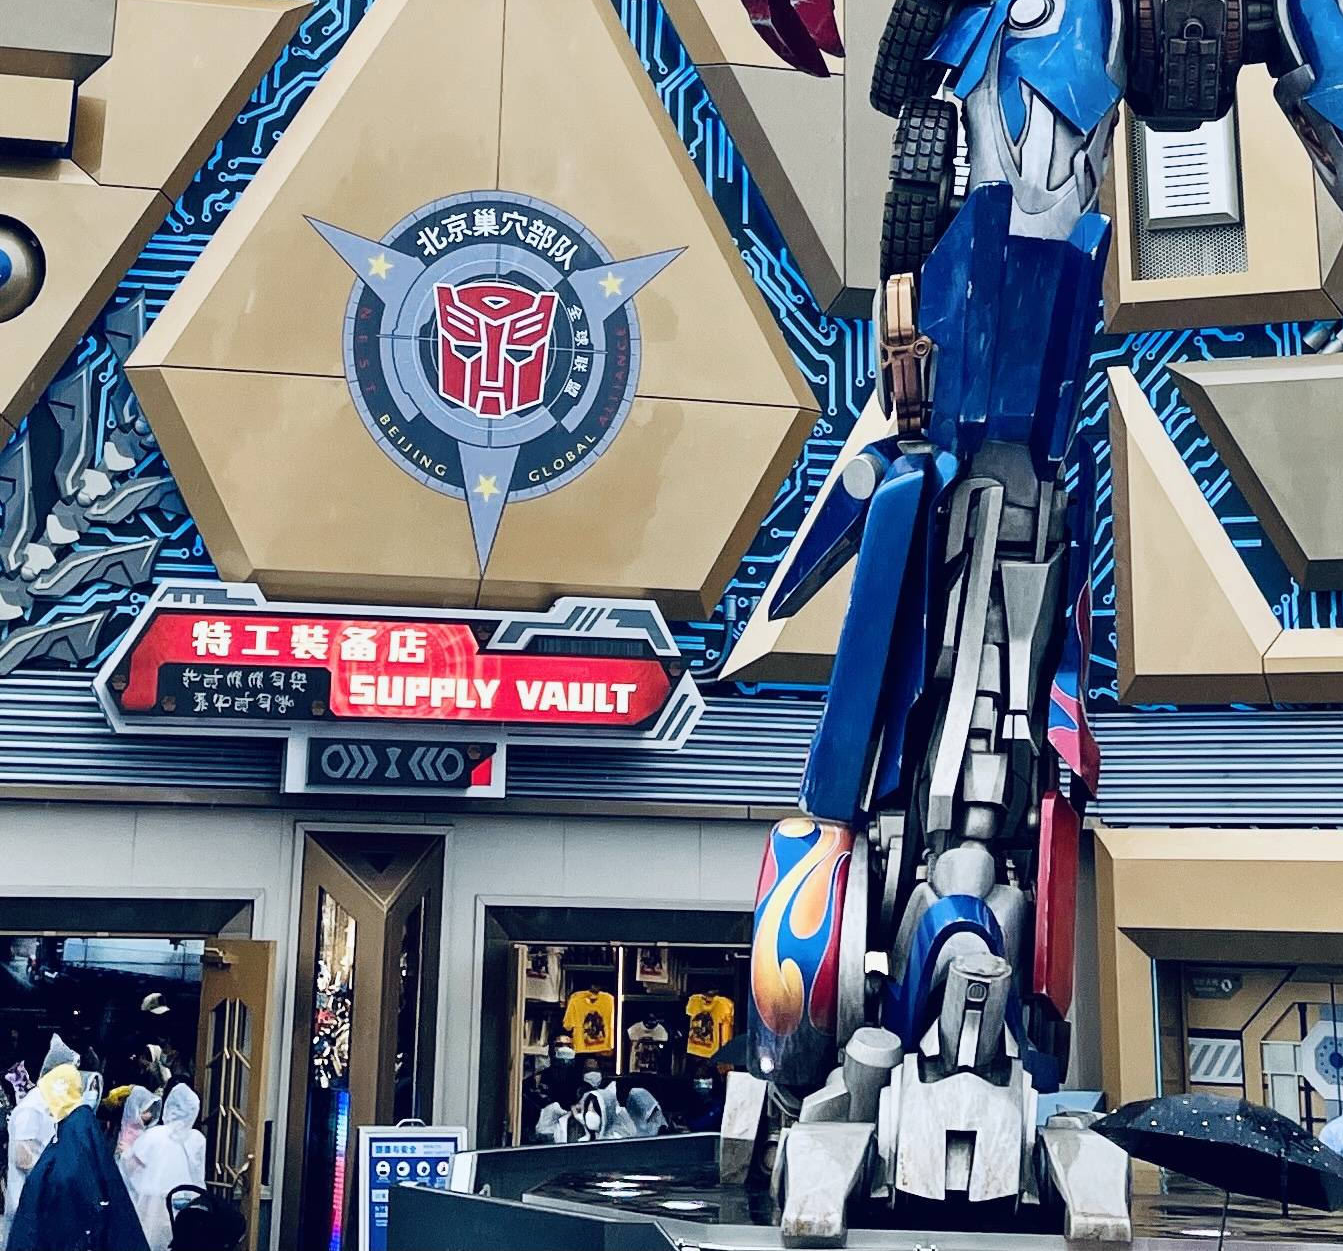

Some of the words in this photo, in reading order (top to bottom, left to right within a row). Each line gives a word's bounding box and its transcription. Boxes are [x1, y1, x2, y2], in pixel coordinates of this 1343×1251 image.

[416, 208, 579, 271] 北京巢穴部队
[563, 304, 590, 398] 全球联盟
[378, 413, 449, 477] BEIJING
[528, 433, 597, 482] GLOBAL
[192, 620, 428, 664] 特工装备店
[348, 674, 501, 712] SUPPLY
[515, 679, 638, 715] VAULT
